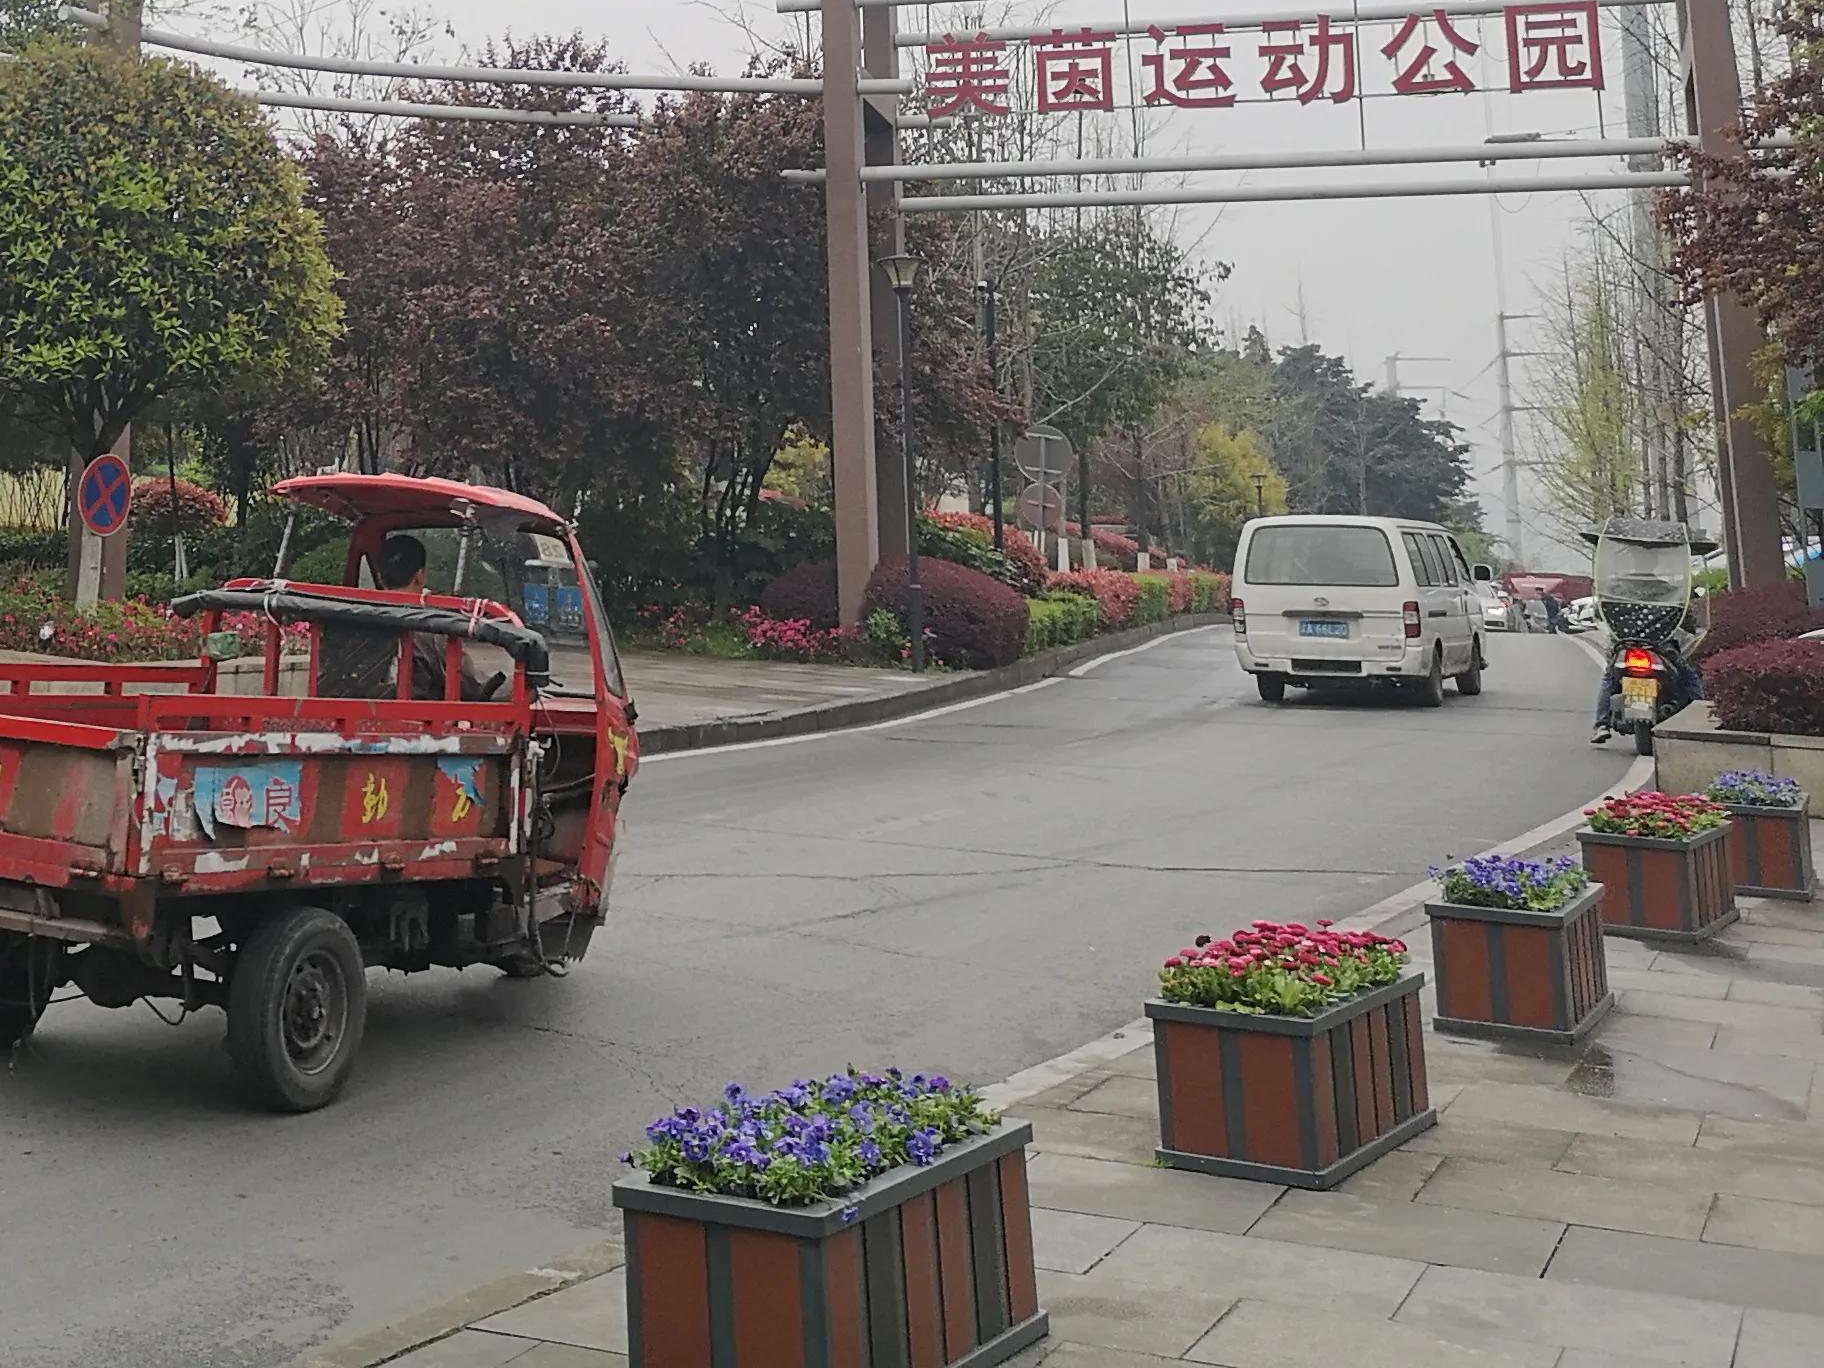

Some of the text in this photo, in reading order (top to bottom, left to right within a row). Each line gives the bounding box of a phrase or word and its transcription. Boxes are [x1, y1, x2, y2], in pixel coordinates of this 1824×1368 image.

[926, 1, 1605, 118] 美茵运动公园
